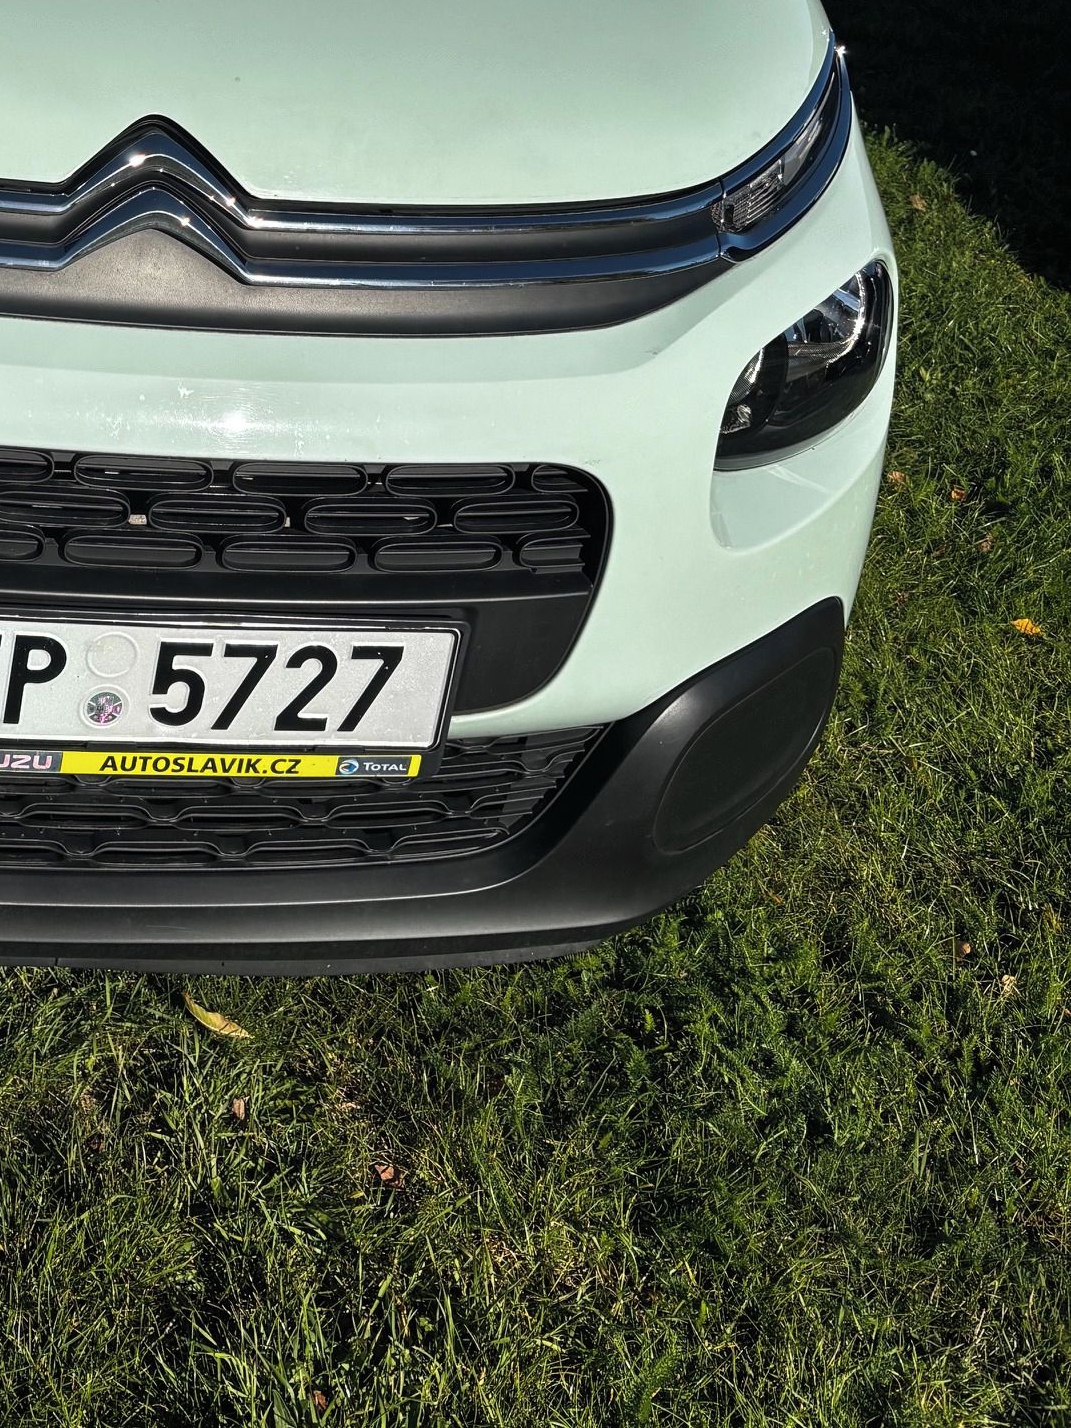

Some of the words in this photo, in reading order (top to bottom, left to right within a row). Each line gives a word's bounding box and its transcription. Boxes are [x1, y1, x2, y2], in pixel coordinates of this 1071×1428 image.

[149, 641, 405, 732] 5727
[99, 755, 302, 775] AUTOSLAVIK.CZ
[362, 761, 407, 772] TOTAL
